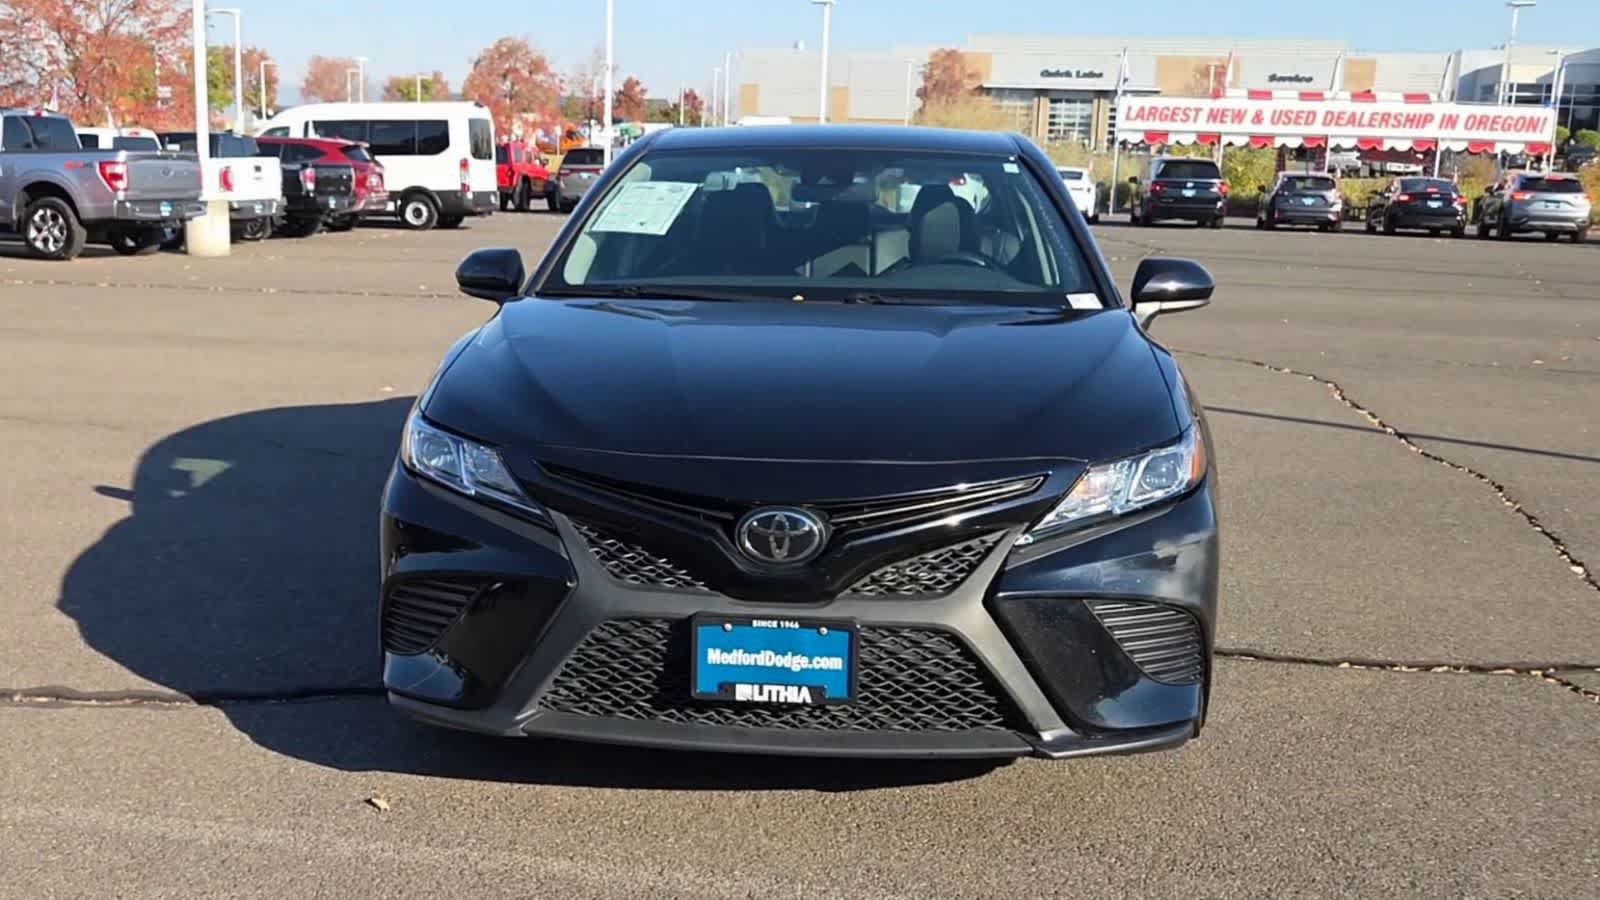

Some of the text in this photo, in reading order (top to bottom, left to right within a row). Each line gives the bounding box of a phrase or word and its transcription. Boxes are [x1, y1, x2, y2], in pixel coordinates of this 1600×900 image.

[1125, 105, 1548, 134] LARGEST NEW & USED DEALERSHIP IN OREGON!
[752, 619, 778, 628] SINCE
[707, 648, 843, 672] MedfordDodge.com
[753, 685, 812, 704] LITHIA
